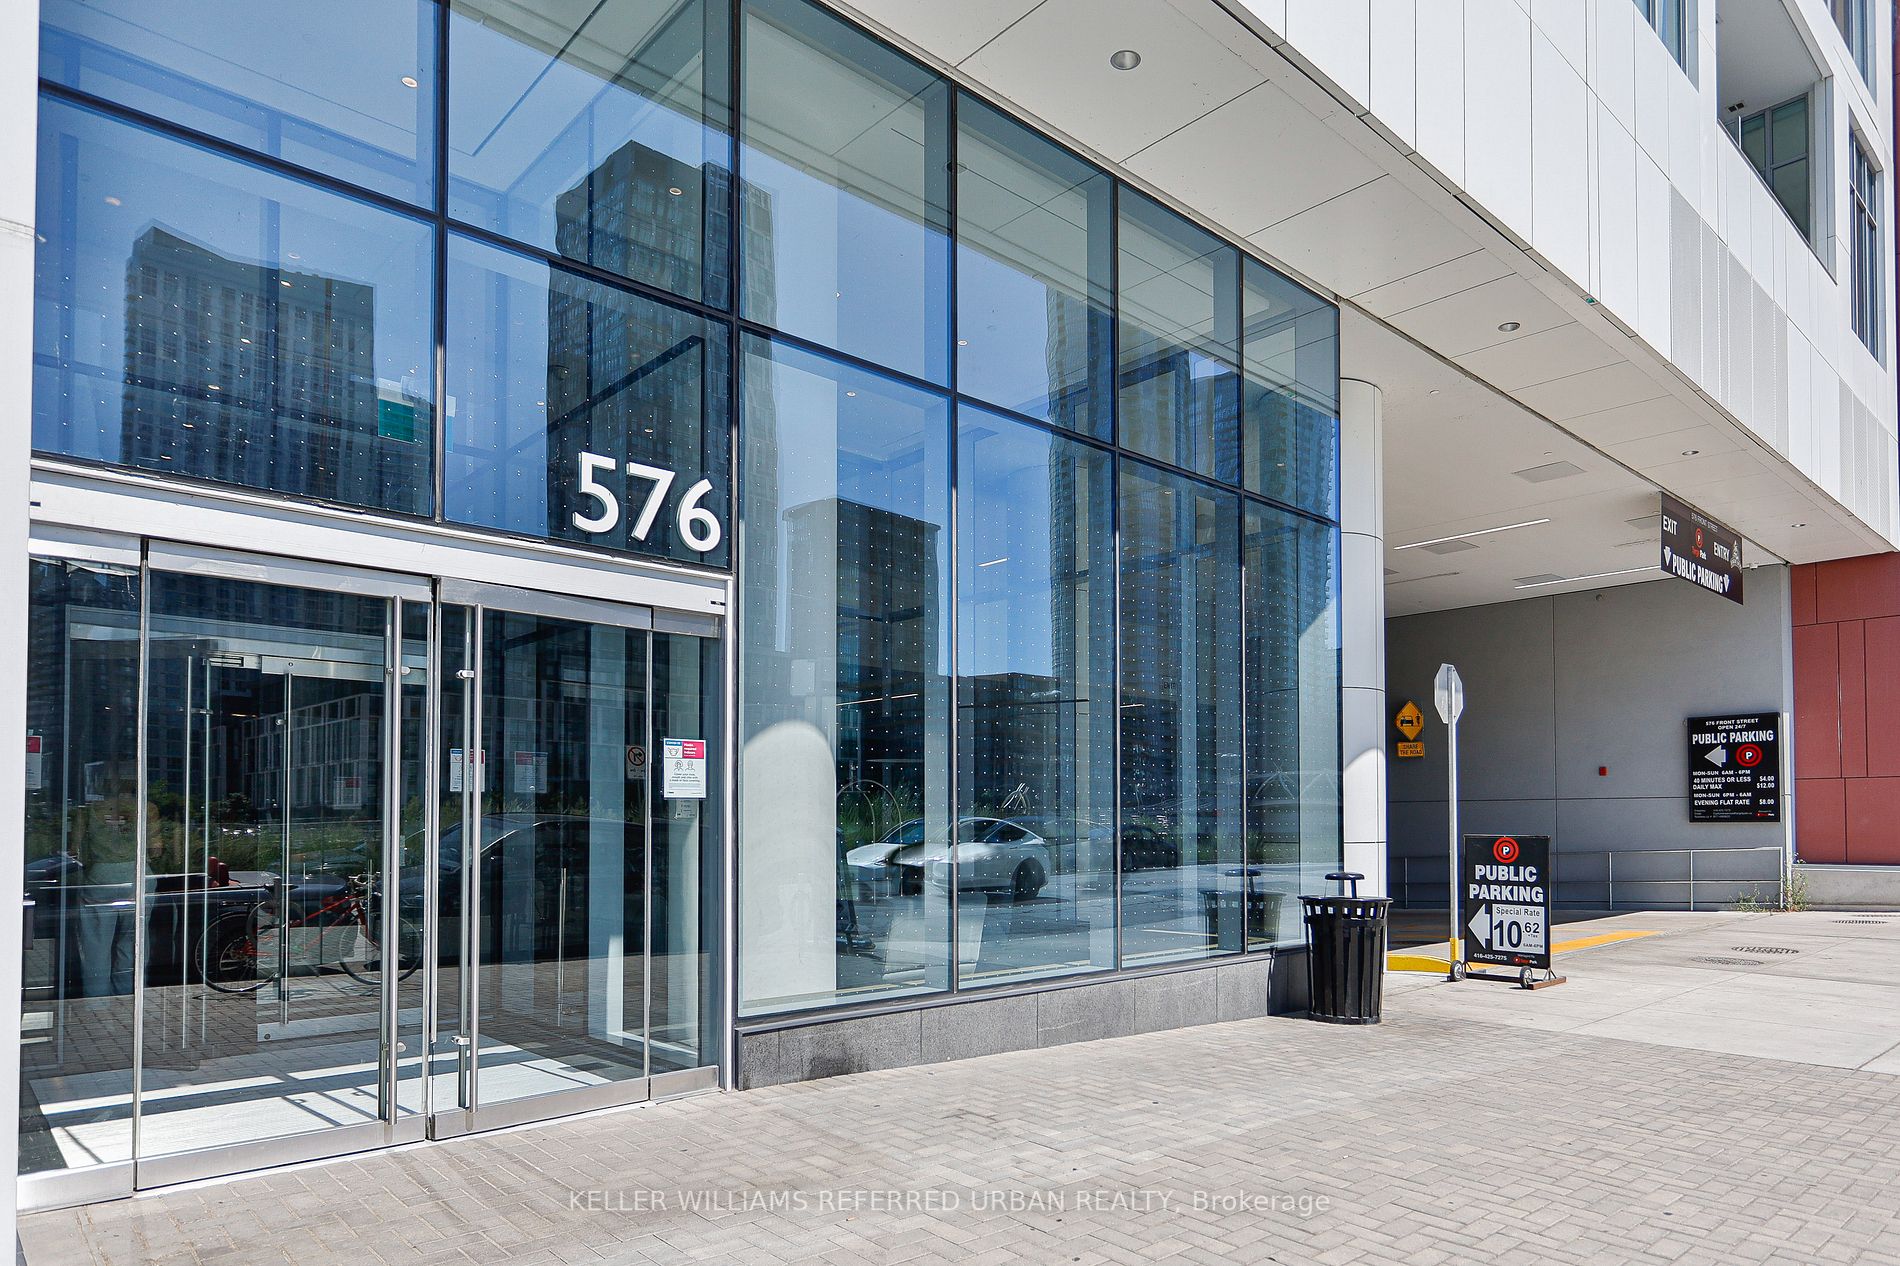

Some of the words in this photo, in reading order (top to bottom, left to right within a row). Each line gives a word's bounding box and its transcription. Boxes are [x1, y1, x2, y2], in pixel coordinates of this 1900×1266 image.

[572, 450, 722, 552] 576
[1662, 514, 1678, 536] EXIT
[1713, 541, 1730, 562] ENTRY
[1672, 553, 1697, 582] PUBLIC
[1697, 565, 1724, 594] PARKING
[1692, 732, 1727, 745] PUBLIC
[1729, 729, 1774, 743] PARKING
[1502, 846, 1510, 856] P
[1474, 864, 1537, 883] PUBLIC
[1469, 883, 1544, 903] PARKING
[1496, 906, 1522, 916] Special
[1523, 908, 1540, 917] Rate
